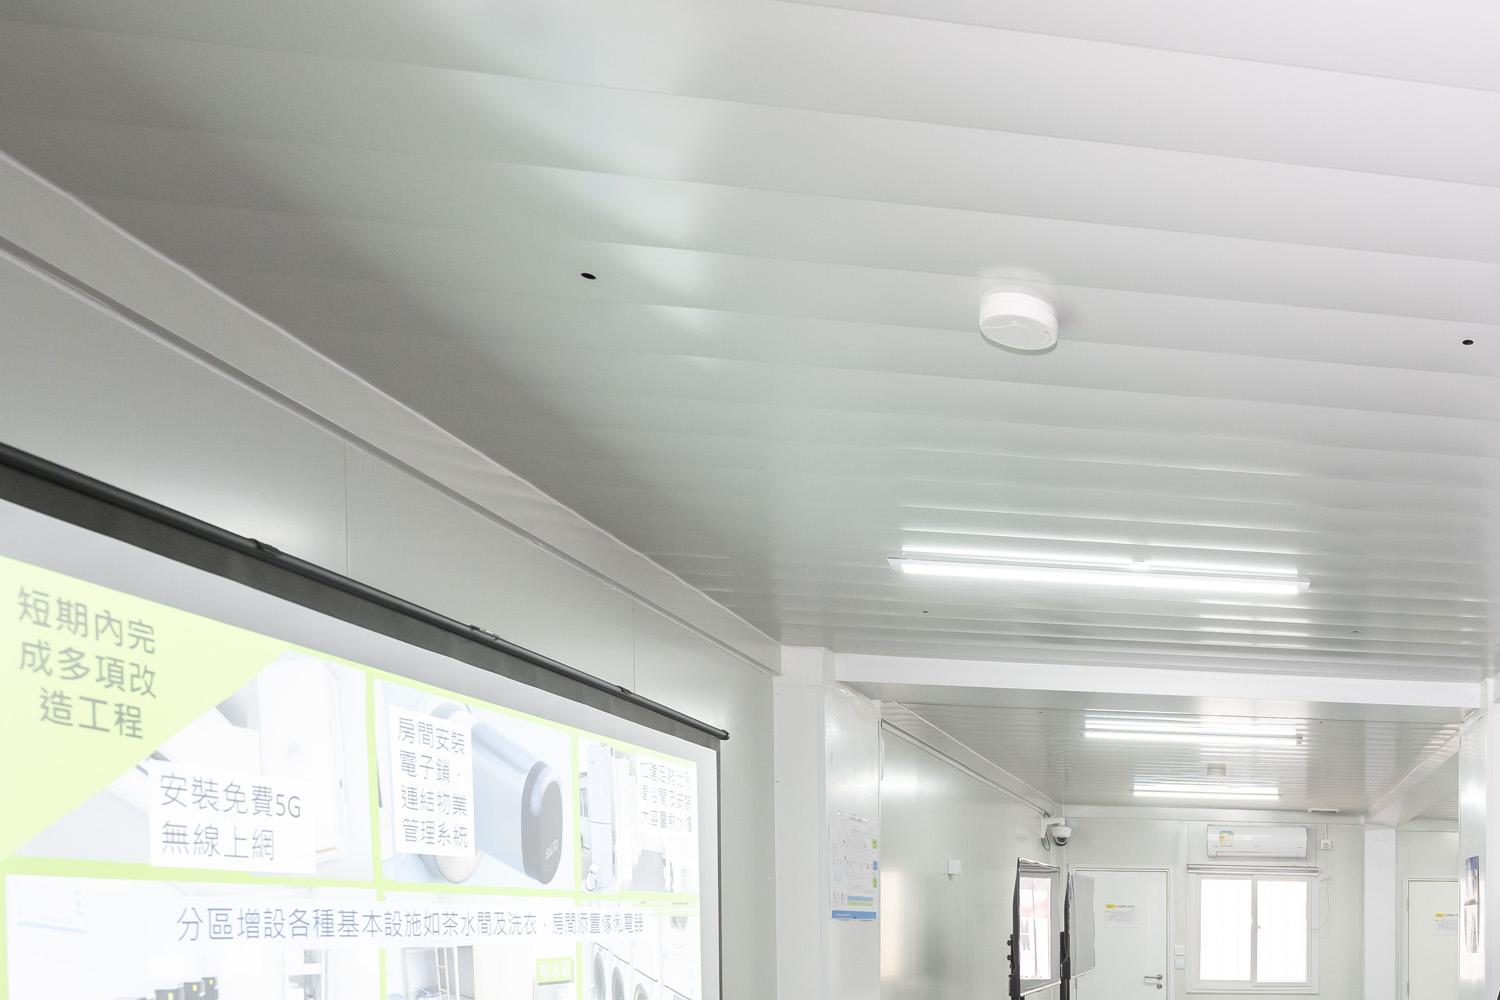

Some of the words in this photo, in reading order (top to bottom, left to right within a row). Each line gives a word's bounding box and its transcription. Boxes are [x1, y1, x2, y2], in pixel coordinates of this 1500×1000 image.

[17, 585, 156, 654] 短期內完
[19, 639, 156, 699] 成多項改
[40, 686, 144, 740] 造工程
[160, 773, 302, 818] 安裝免費5G
[161, 821, 276, 860] 無線上網
[402, 818, 468, 848] 管理系統
